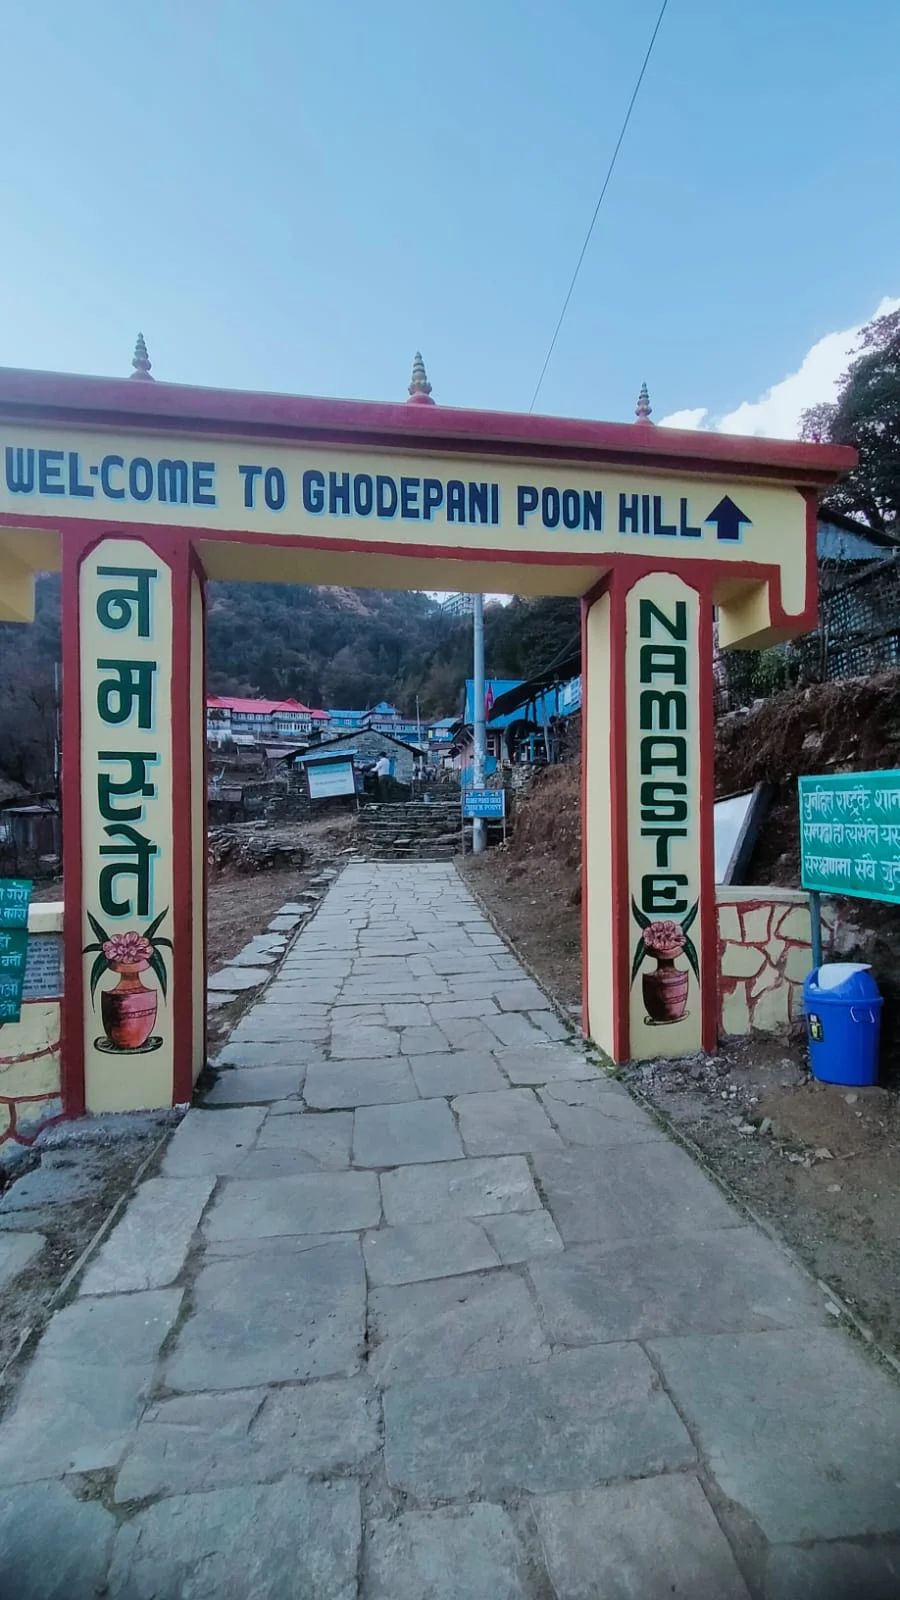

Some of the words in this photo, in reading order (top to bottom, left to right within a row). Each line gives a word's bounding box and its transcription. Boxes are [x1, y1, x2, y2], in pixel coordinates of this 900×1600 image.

[238, 464, 286, 511] TO
[302, 469, 499, 525] GHODEPANI
[517, 485, 602, 532] POON
[618, 492, 702, 538] HILL
[96, 566, 158, 917] नमस्ते
[639, 598, 689, 914] NAMASTE
